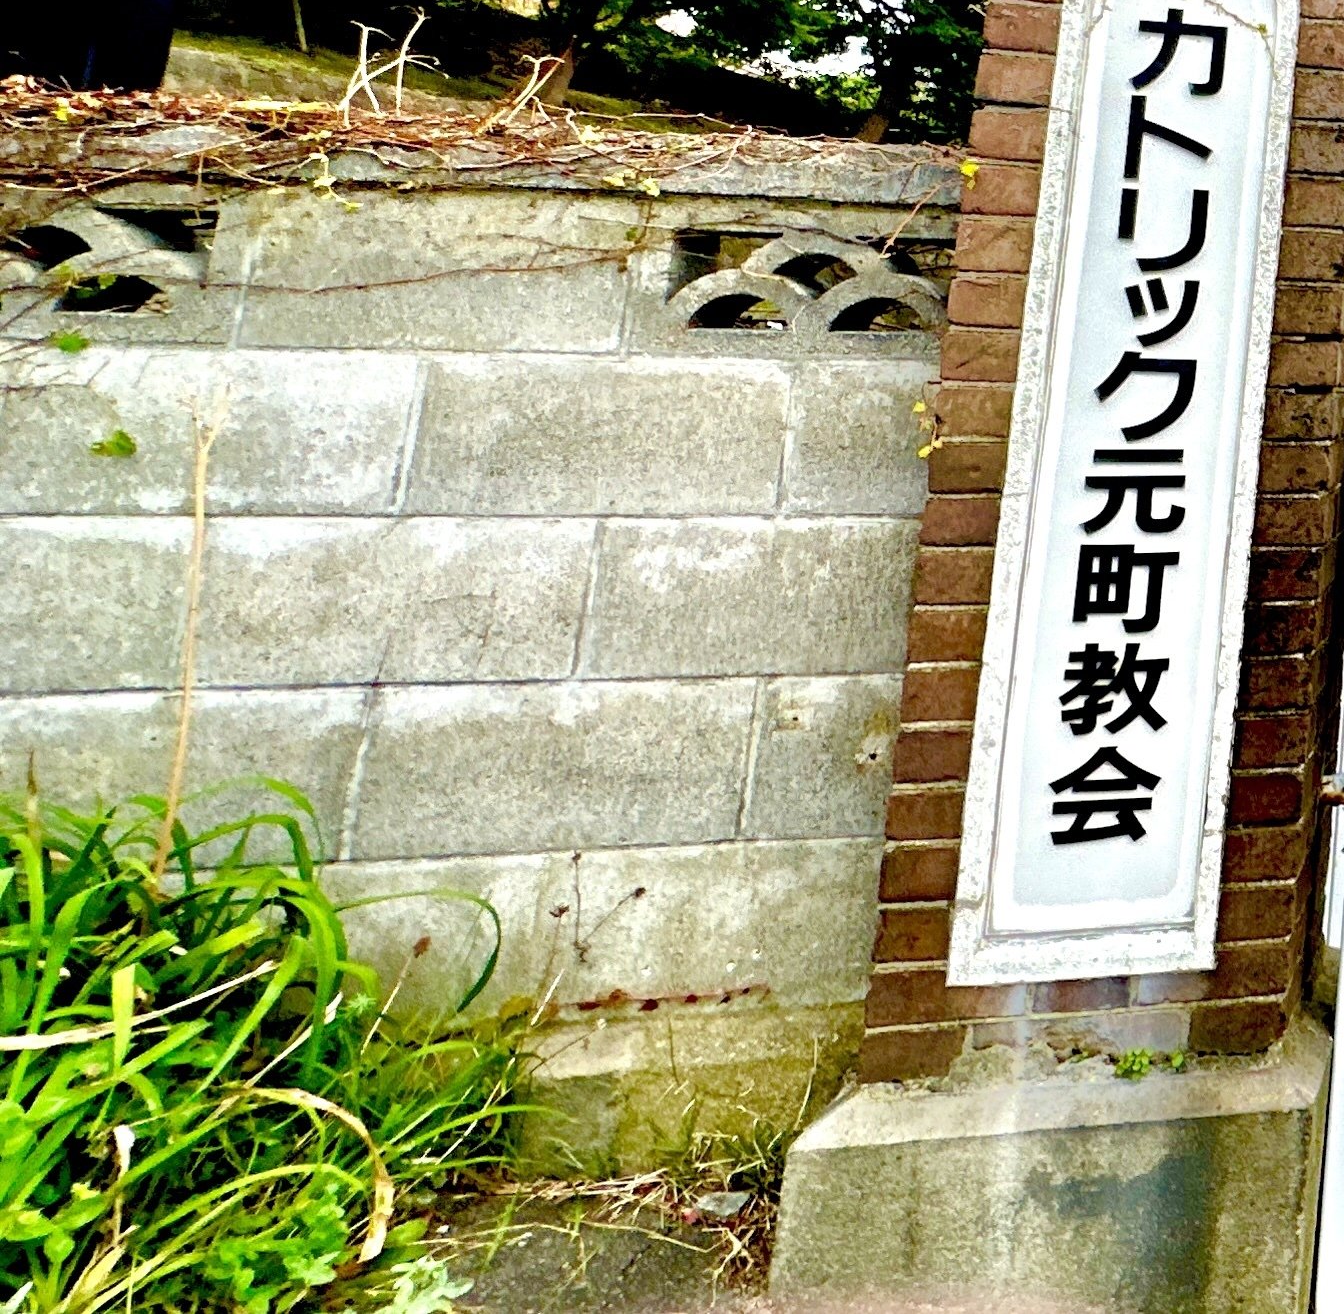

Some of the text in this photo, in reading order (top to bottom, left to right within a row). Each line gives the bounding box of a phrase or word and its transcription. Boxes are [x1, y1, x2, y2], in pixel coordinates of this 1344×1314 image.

[1050, 8, 1229, 846] カトリック元町教会
